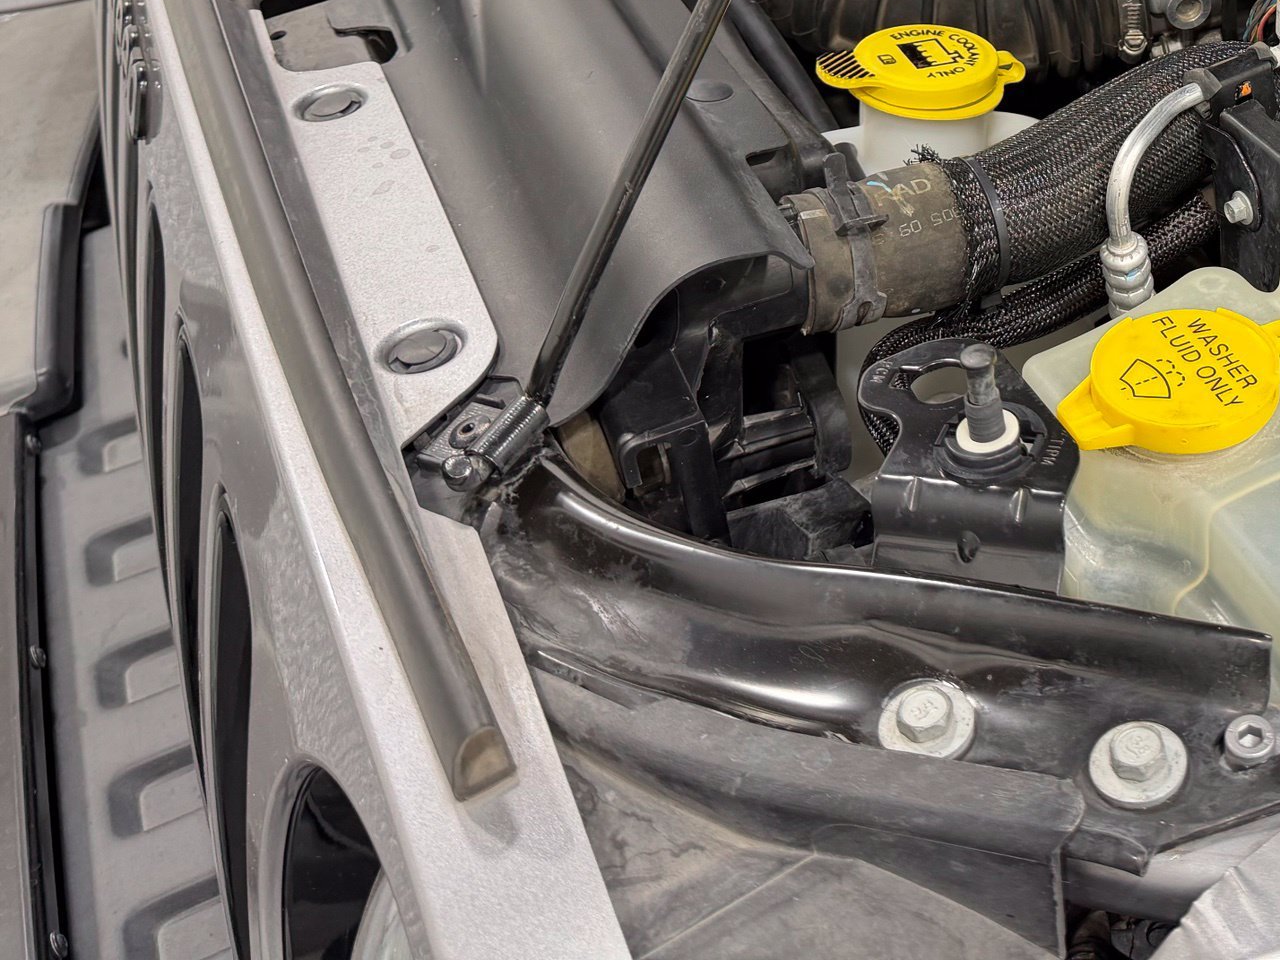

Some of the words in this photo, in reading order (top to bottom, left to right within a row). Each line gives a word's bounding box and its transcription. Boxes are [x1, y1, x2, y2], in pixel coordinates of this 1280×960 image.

[889, 29, 946, 41] ENGINE
[948, 34, 981, 68] COOLANT
[926, 66, 965, 79] ONLY
[1152, 315, 1202, 363] FLUID
[1196, 365, 1245, 408] ONLY
[1187, 317, 1258, 390] WASHER
